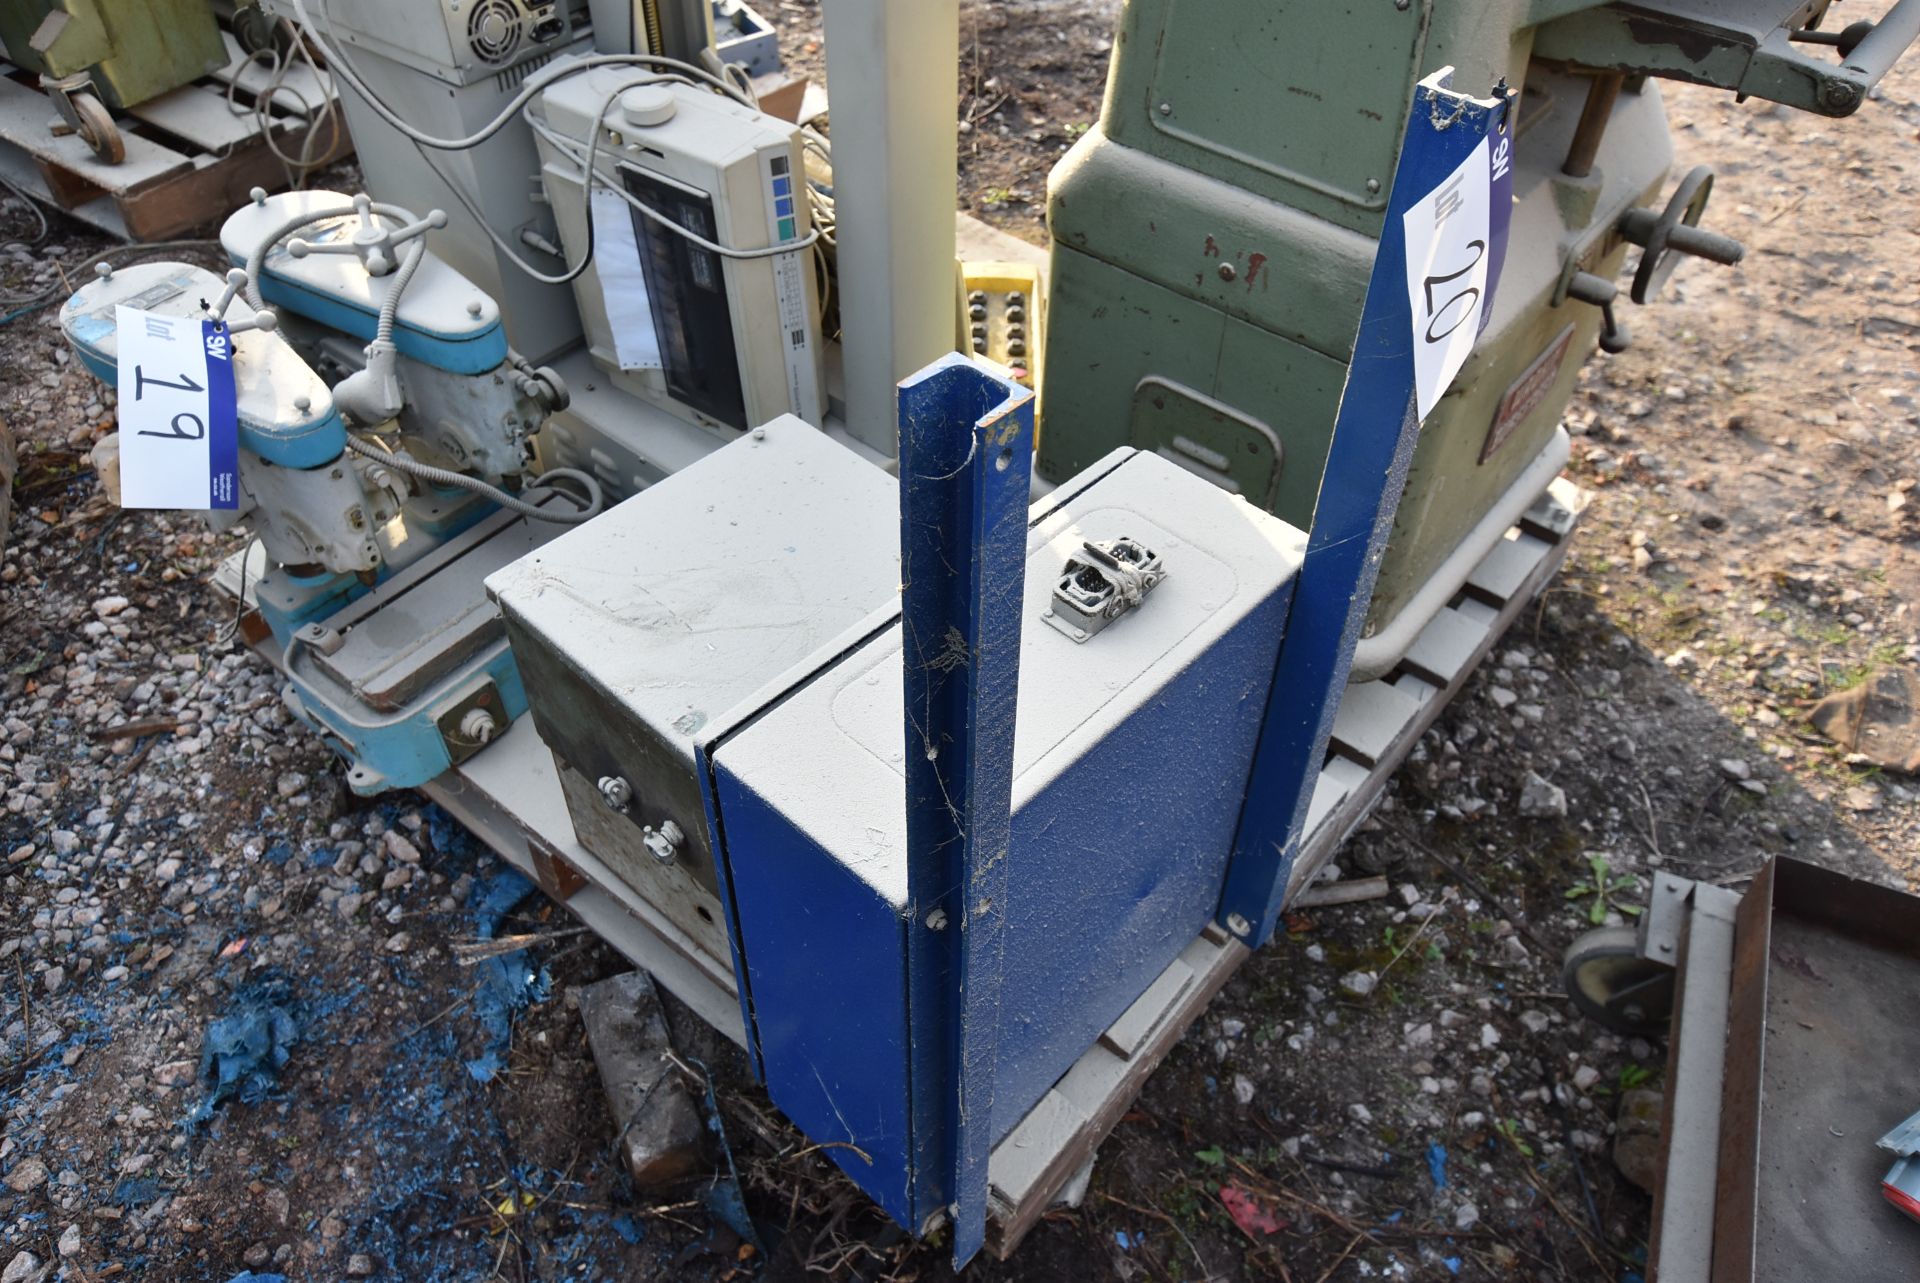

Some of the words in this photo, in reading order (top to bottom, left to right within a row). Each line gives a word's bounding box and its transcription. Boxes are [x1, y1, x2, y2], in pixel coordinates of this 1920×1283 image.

[1491, 138, 1510, 182] SW
[1434, 172, 1464, 231] Lot
[1423, 239, 1486, 344] 20
[146, 317, 176, 342] Lot
[205, 335, 227, 361] SW
[135, 365, 205, 440] 19
